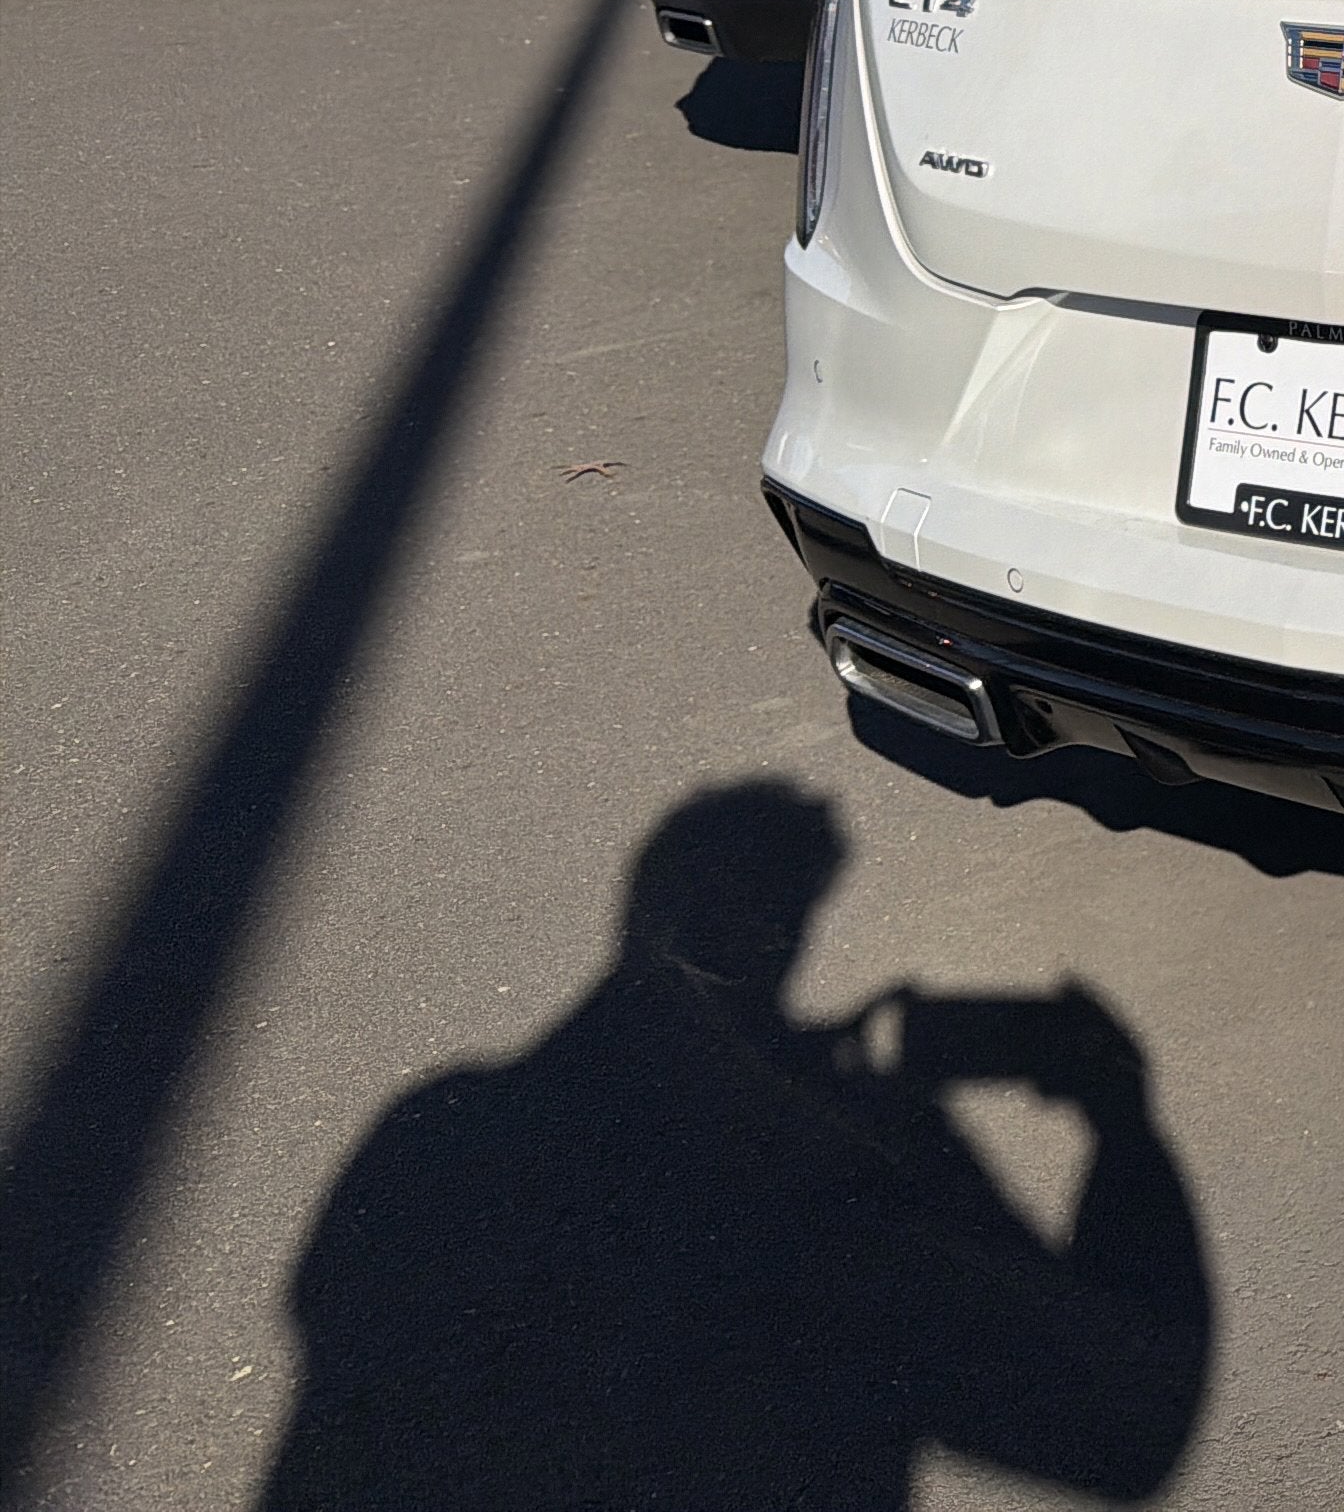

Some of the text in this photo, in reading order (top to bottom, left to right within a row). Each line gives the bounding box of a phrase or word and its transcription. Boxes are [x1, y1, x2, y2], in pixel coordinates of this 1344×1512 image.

[887, 18, 964, 54] KERBECK
[918, 150, 989, 178] AWD
[1210, 377, 1278, 431] F.C.
[1208, 437, 1248, 458] Family
[1250, 442, 1296, 462] Owned
[1299, 450, 1308, 464] &
[1248, 495, 1292, 532] F.C.
